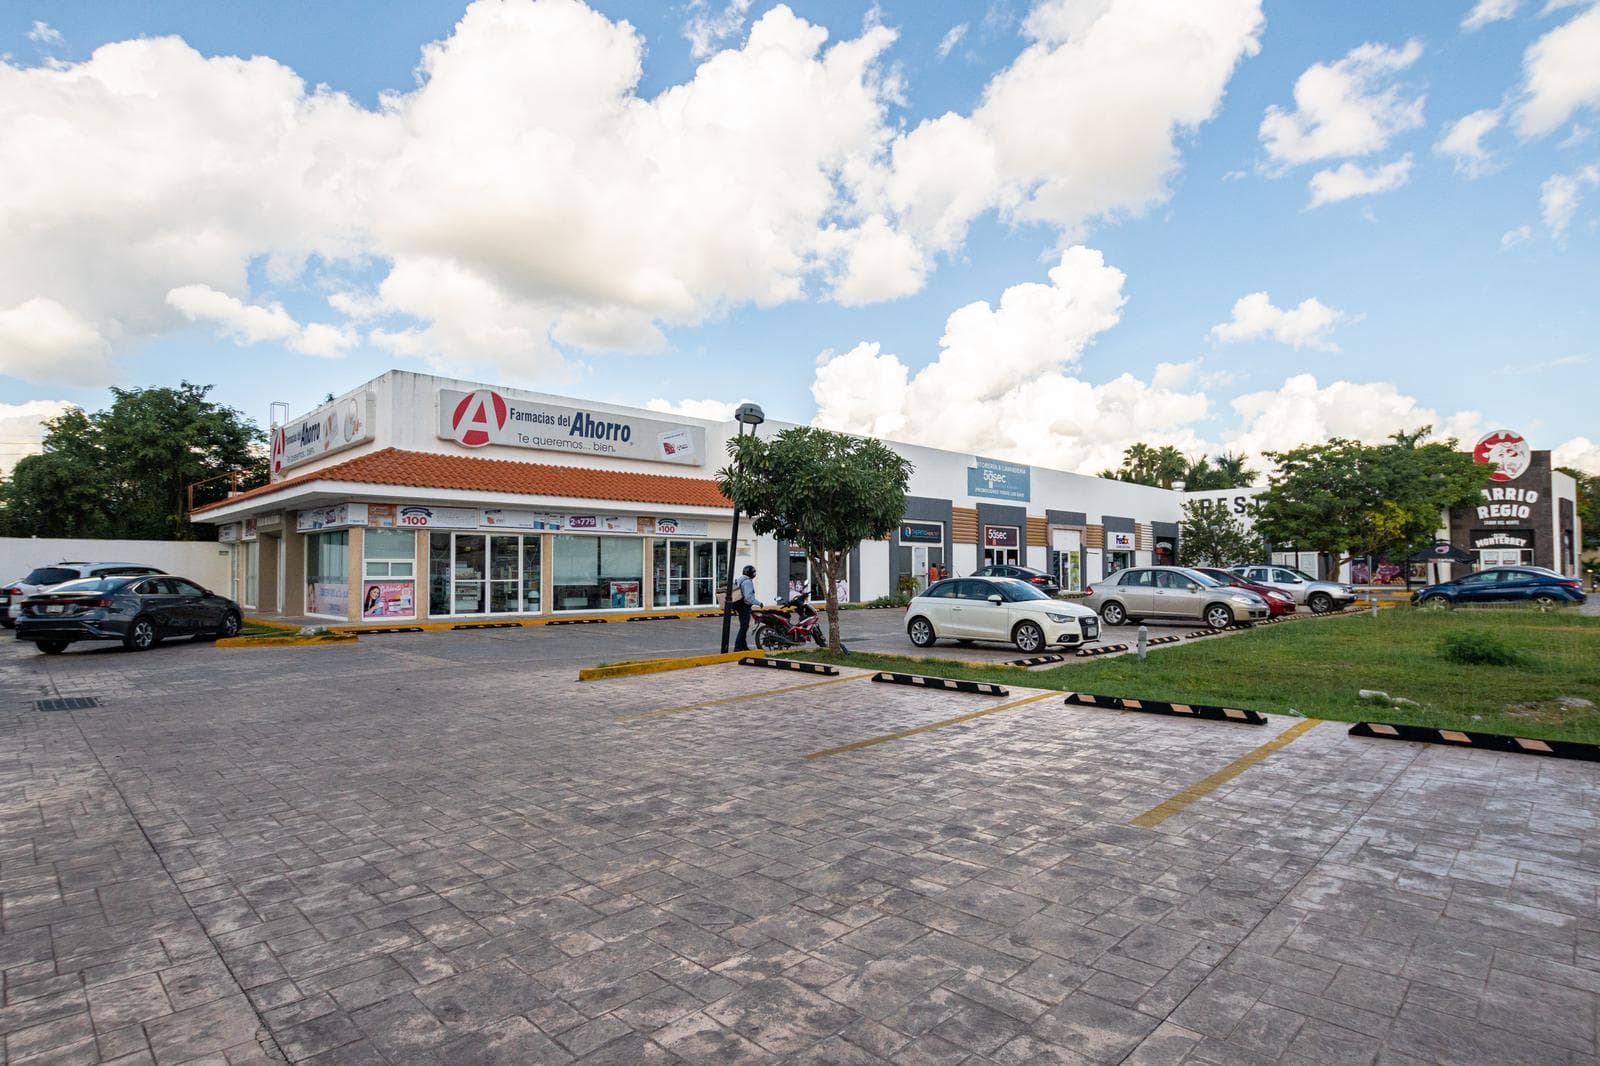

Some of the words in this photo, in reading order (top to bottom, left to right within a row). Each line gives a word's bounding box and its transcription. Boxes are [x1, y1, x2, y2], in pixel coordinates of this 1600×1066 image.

[510, 407, 555, 426] Farmacias
[557, 414, 571, 427] del
[569, 411, 631, 443] Ahorro
[300, 421, 321, 448] Ahorro
[518, 433, 530, 444] Te
[533, 437, 591, 450] queremos...
[593, 441, 616, 453] bien.
[1480, 487, 1538, 504] ARRIO
[1476, 504, 1530, 520] REGIO
[1115, 534, 1129, 545] FedEx
[1475, 536, 1528, 548] MONTERREY
